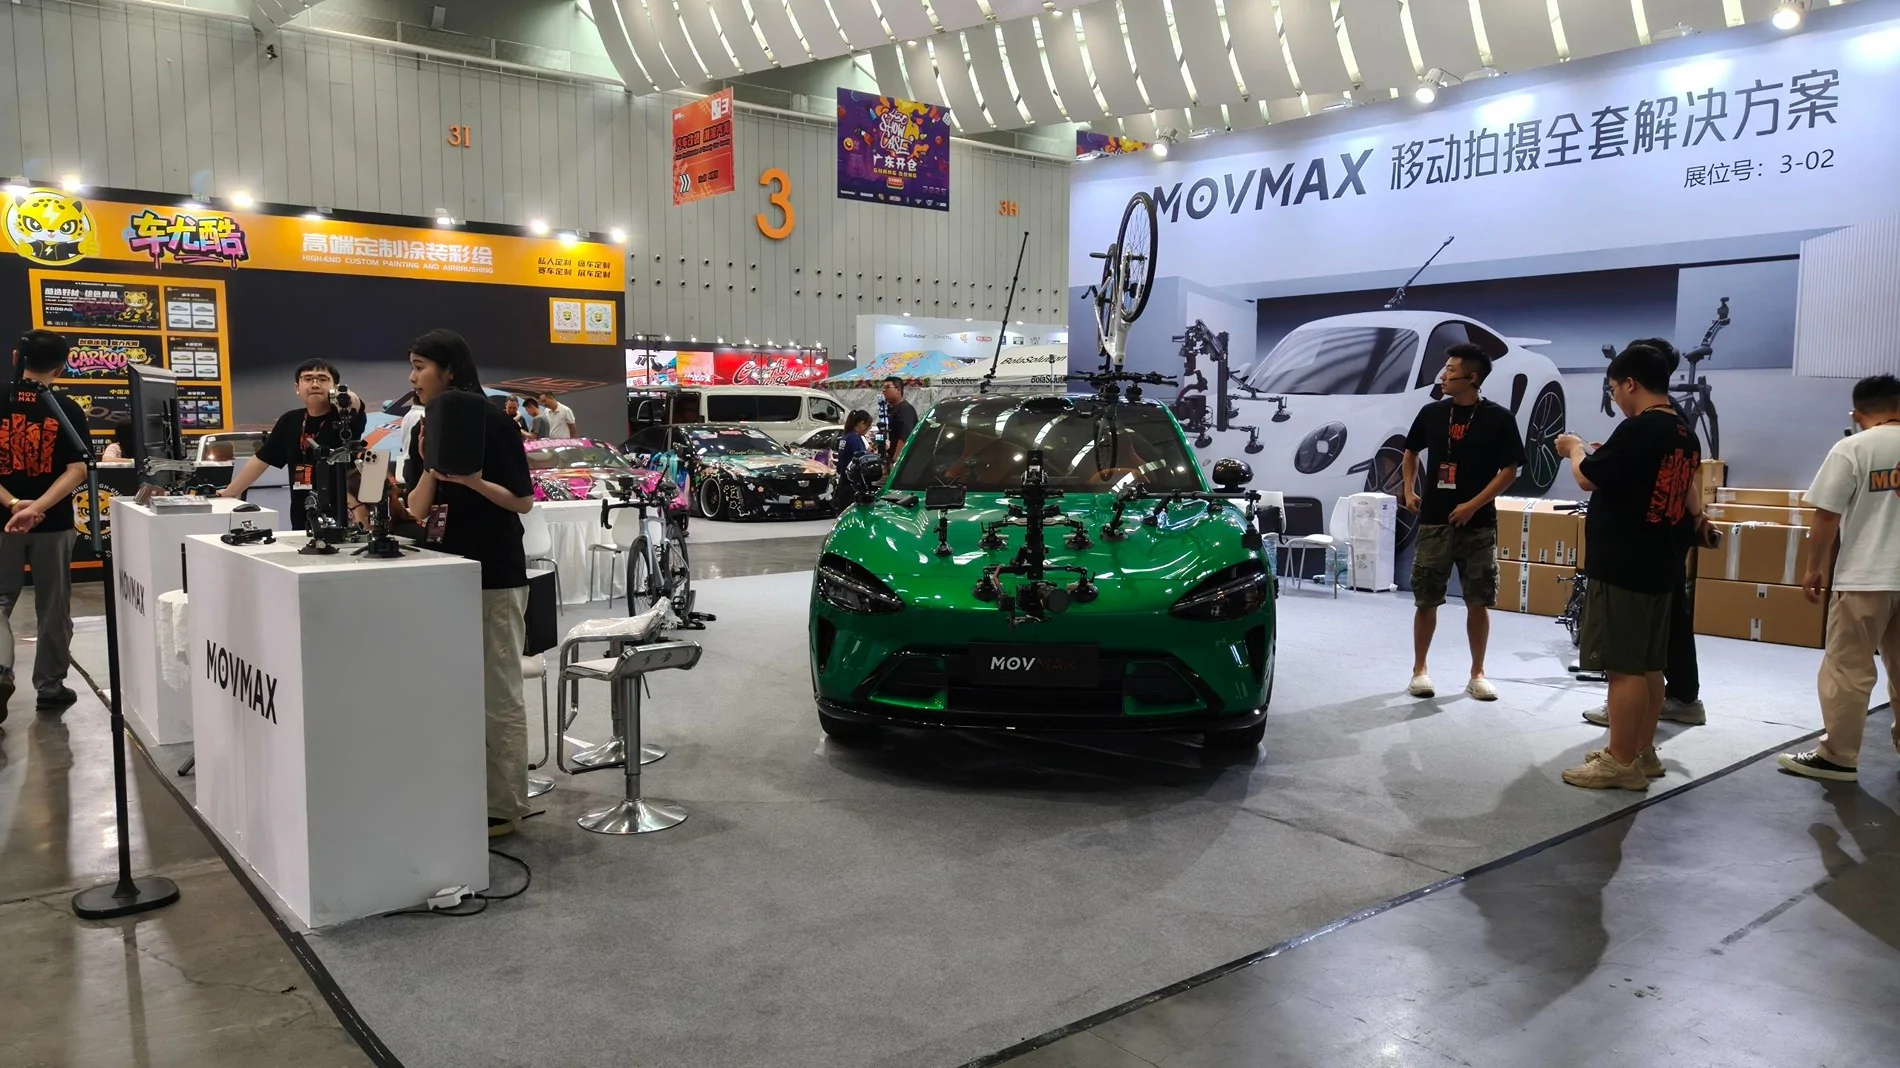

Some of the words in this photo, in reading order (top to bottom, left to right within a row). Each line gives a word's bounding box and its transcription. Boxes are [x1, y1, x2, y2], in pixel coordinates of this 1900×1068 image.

[873, 153, 918, 172] 广东开仓
[1152, 148, 1374, 223] MOVMAX
[1390, 68, 1840, 190] 移动拍摄全套解决方案
[1780, 148, 1835, 174] 3-02
[755, 167, 796, 240] 3
[130, 210, 248, 264] 车尤酷
[302, 233, 493, 266] 高端定制涂装彩绘
[345, 257, 380, 266] CUSTOM
[383, 260, 419, 269] PAINTING
[423, 262, 440, 270] AND
[443, 264, 494, 274] AIRBRUSHING
[67, 349, 129, 371] CARKOO
[119, 568, 145, 617] MOVMAX
[206, 639, 278, 725] MOVMAX
